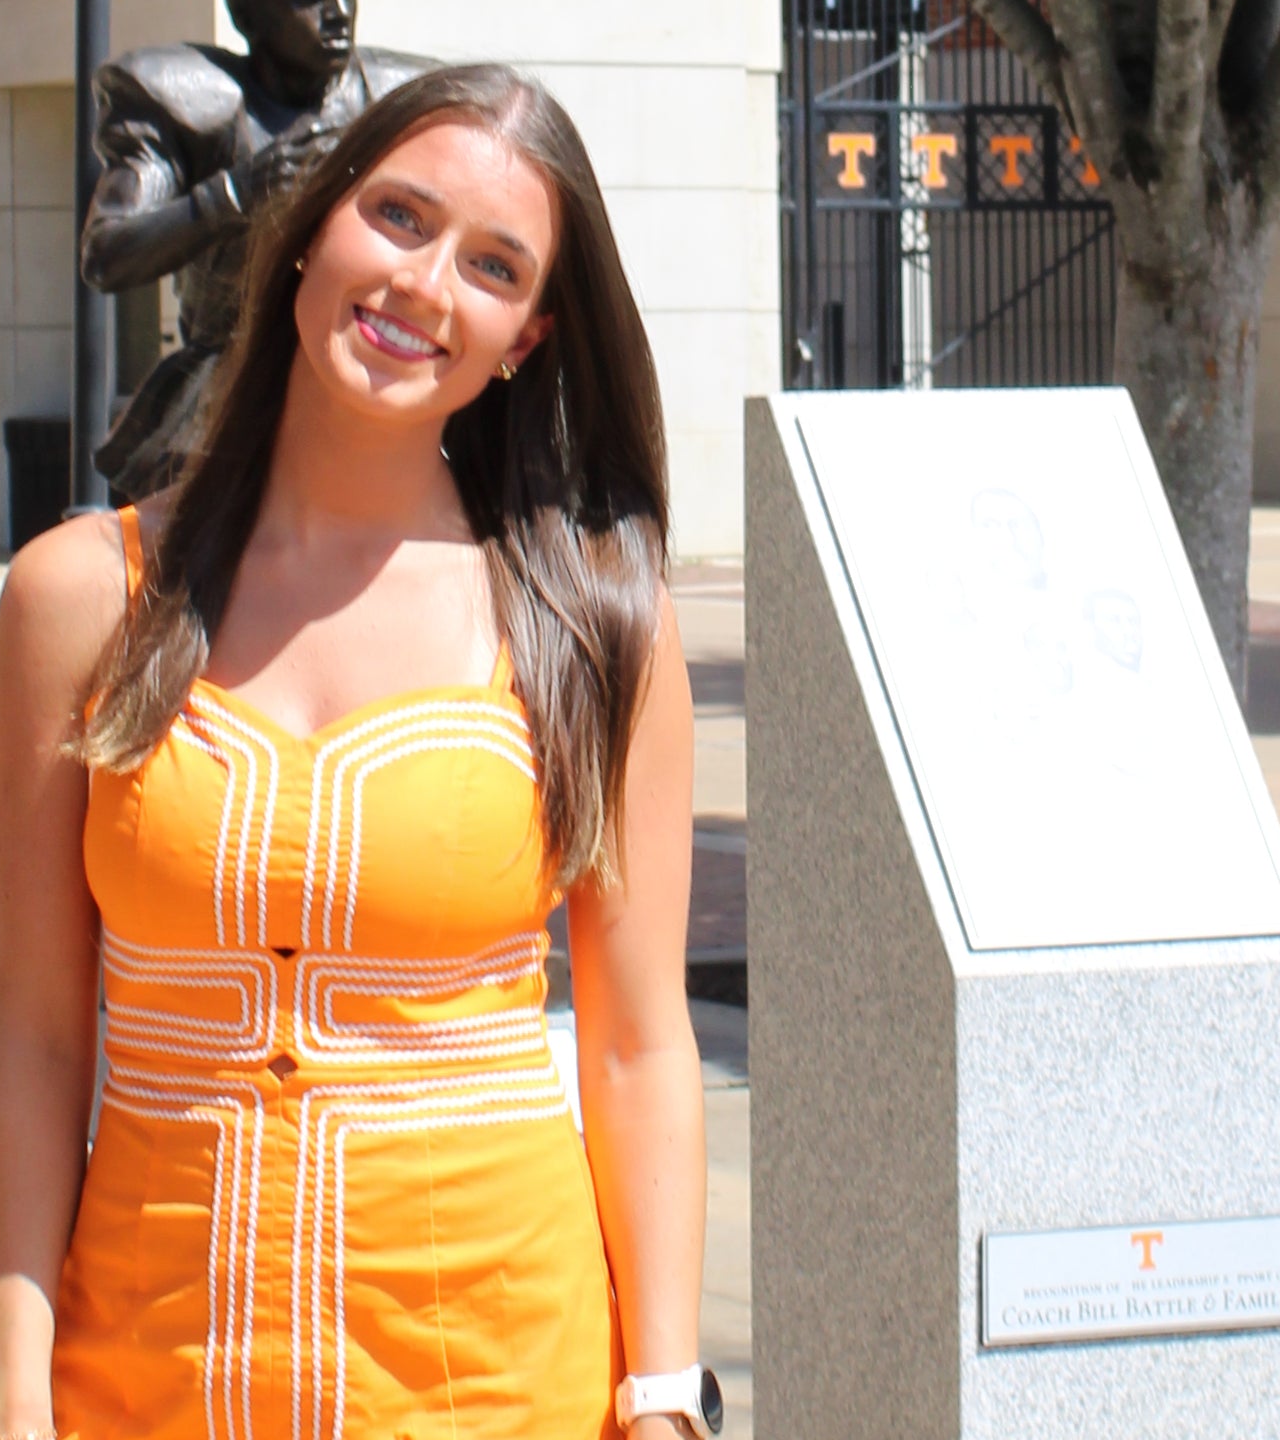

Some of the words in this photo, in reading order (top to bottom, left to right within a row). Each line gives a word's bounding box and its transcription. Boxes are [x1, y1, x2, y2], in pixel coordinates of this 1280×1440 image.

[1131, 1231, 1163, 1271] T
[1001, 1302, 1071, 1328] COACH
[1077, 1300, 1117, 1322] BILL
[1125, 1295, 1197, 1319] BATTLE
[1203, 1293, 1217, 1311] &
